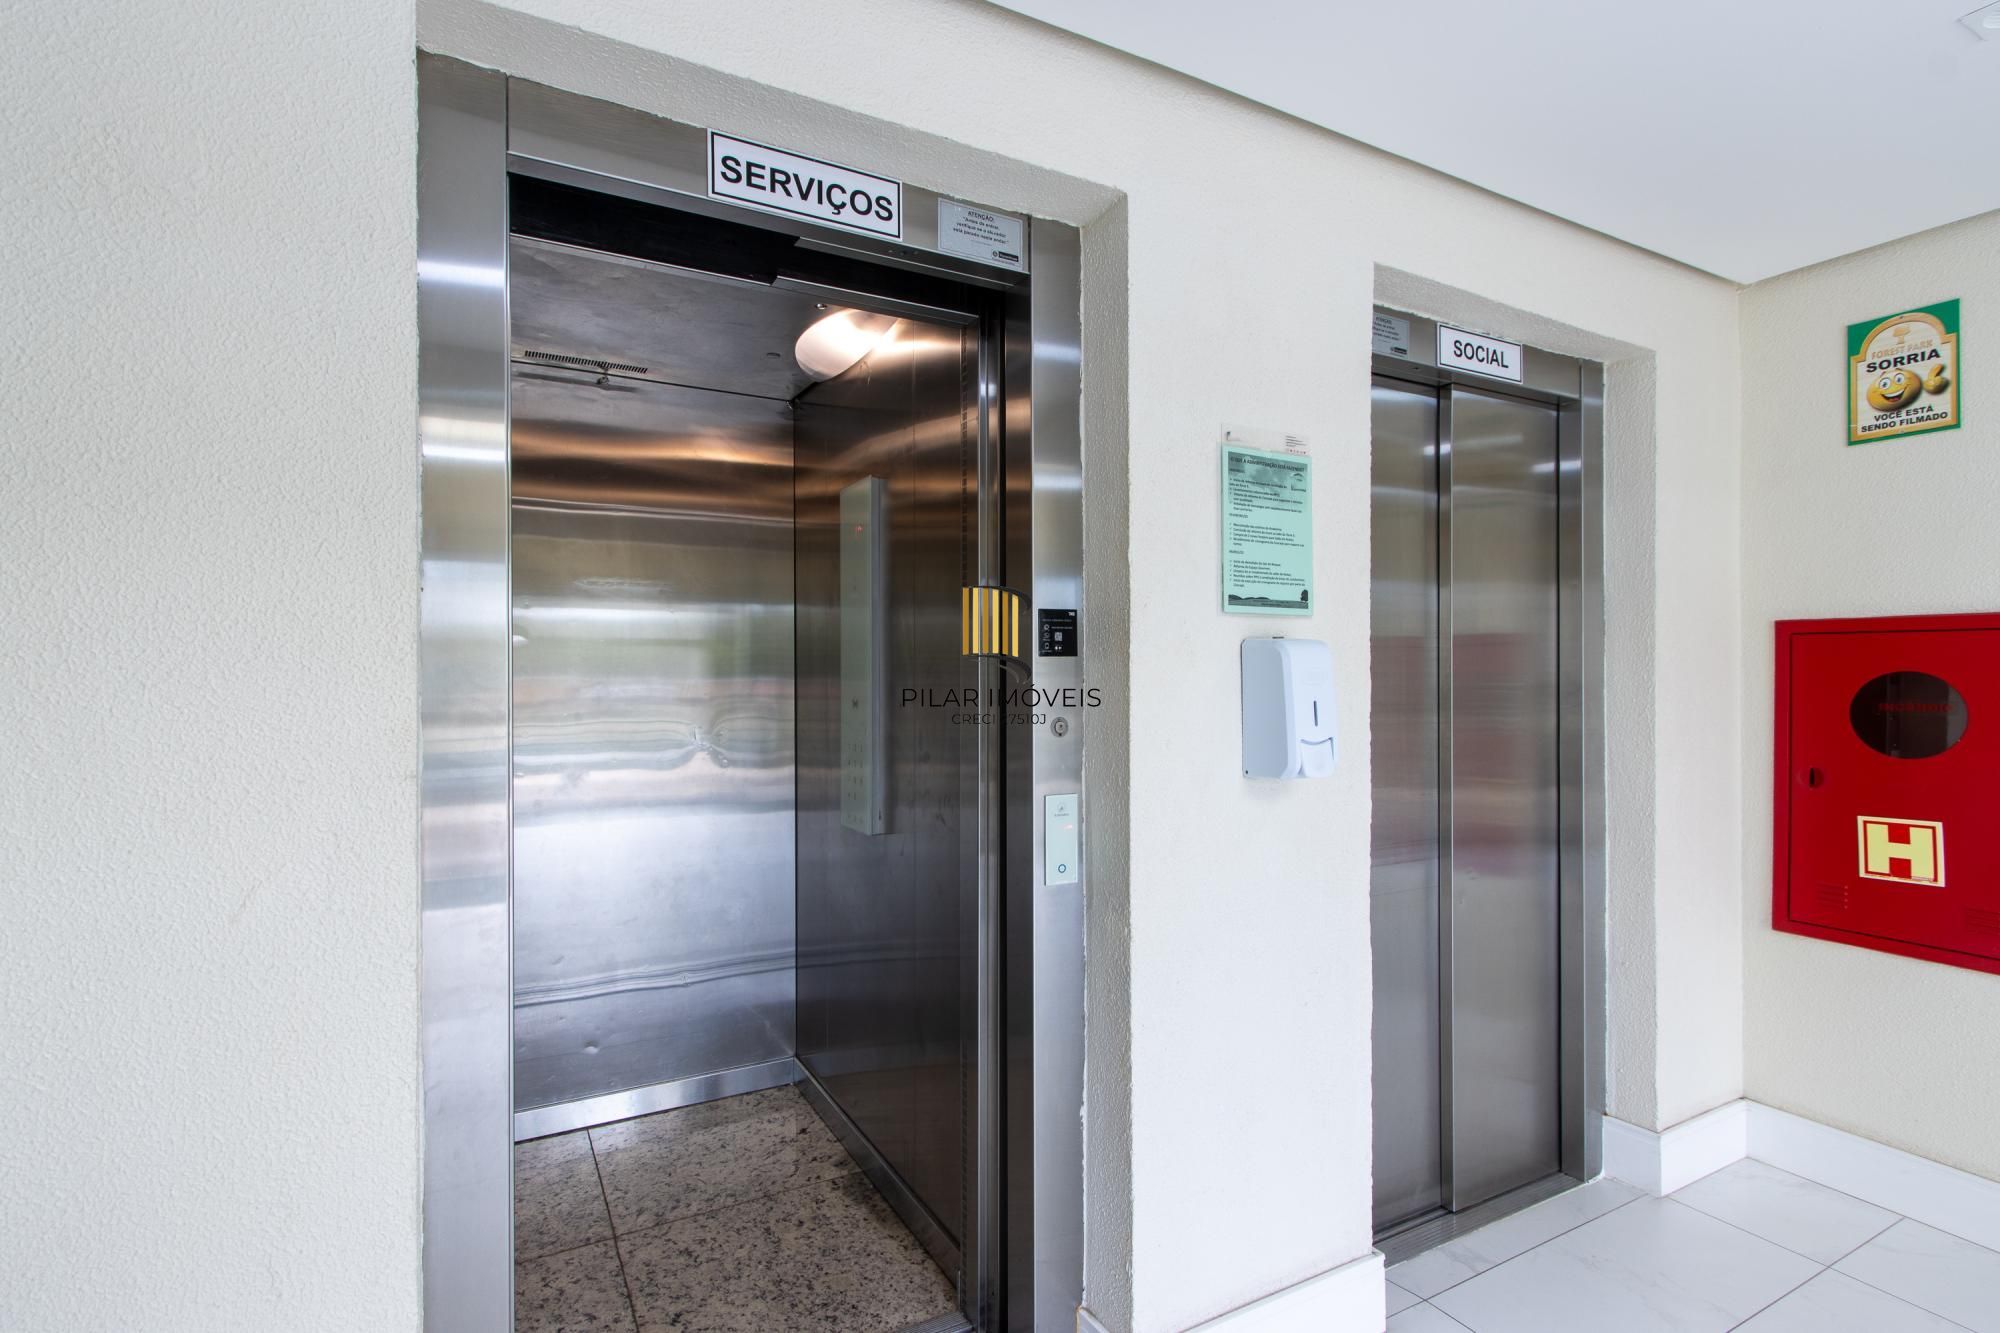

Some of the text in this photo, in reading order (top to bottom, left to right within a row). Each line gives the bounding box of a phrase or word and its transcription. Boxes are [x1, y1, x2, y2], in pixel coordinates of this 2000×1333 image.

[720, 155, 893, 221] SERVIÇOS
[1453, 339, 1509, 368] SOCIAL
[1866, 348, 1941, 373] SORRIA
[1861, 411, 1948, 433] SENDO FILMADO
[1906, 404, 1934, 417] ESTÁ
[1866, 822, 1935, 882] H
